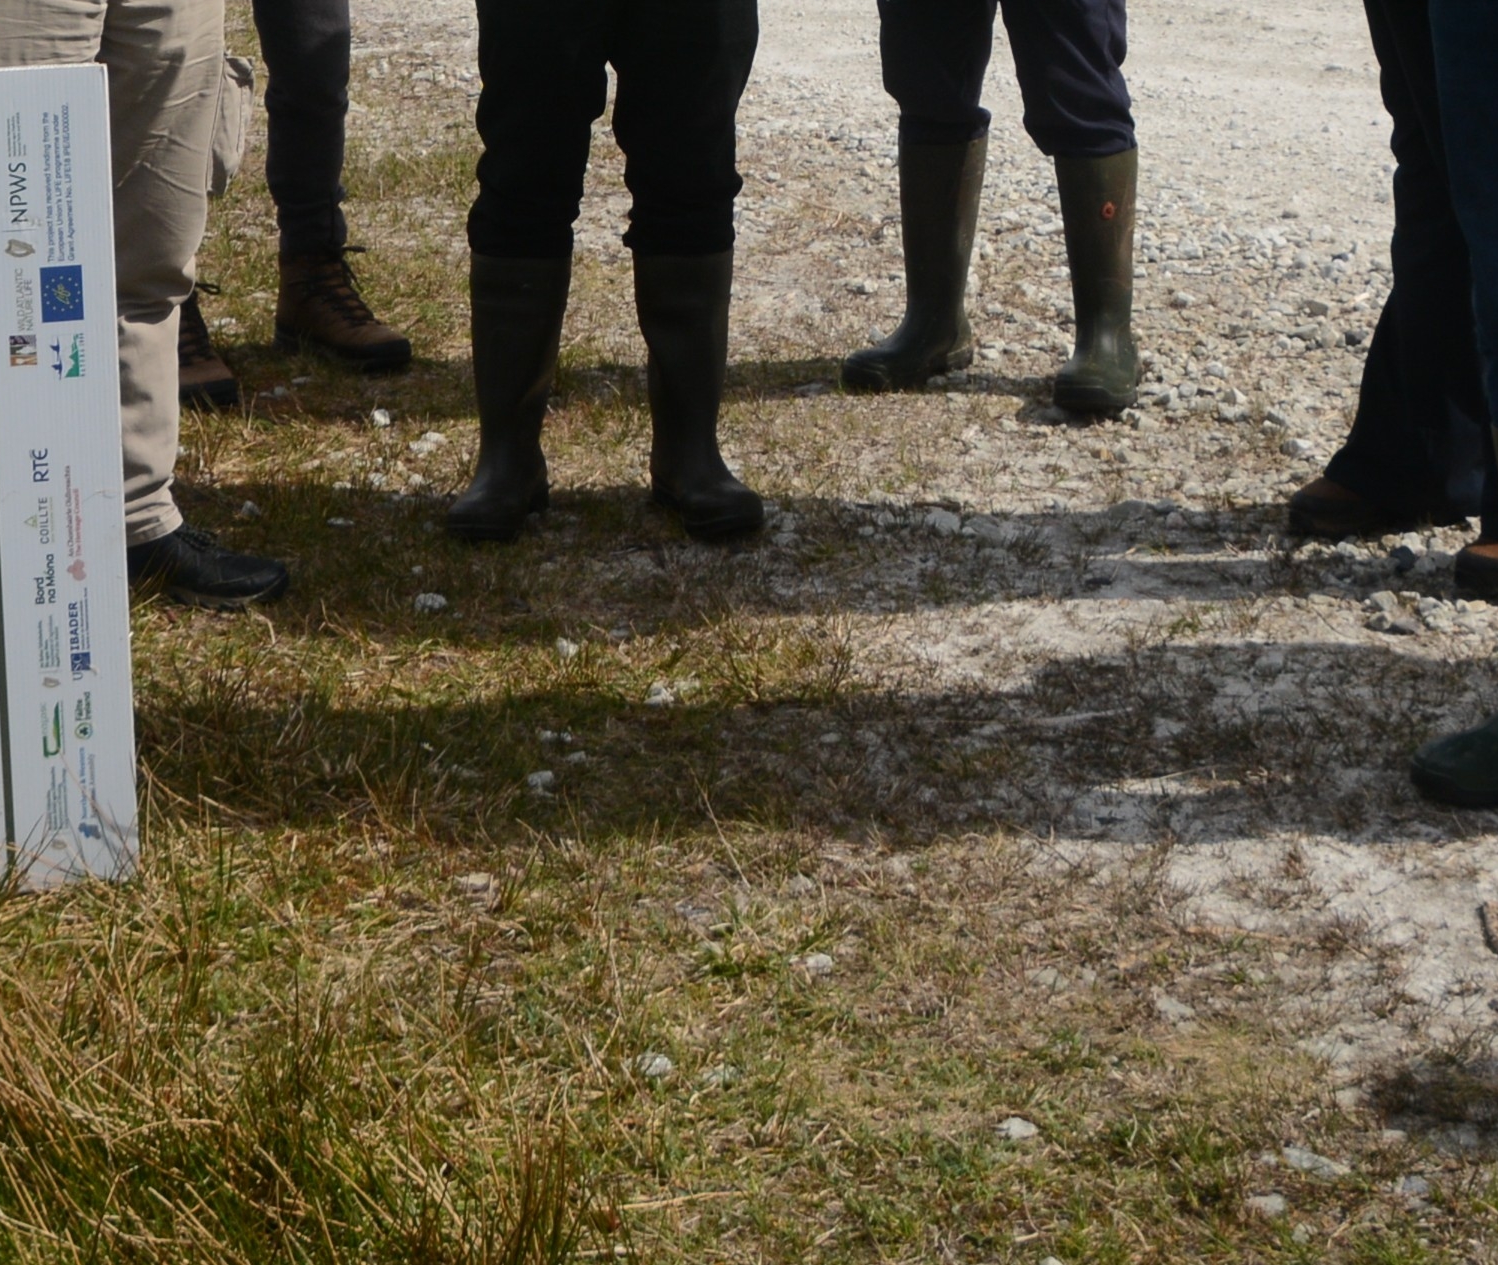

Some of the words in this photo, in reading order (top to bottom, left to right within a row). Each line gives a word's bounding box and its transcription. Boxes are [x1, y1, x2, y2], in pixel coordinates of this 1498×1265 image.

[42, 125, 50, 143] from
[52, 114, 60, 135] under
[43, 144, 52, 172] funding
[53, 137, 63, 179] programme
[8, 162, 28, 224] NPWS
[44, 173, 52, 204] received
[54, 180, 62, 198] LIFE
[44, 205, 53, 219] has
[54, 198, 64, 226] Union's
[65, 199, 76, 239] Agreement
[45, 220, 55, 246] project
[55, 227, 65, 262] European
[47, 247, 55, 263] This
[66, 240, 75, 262] Grant
[15, 268, 23, 307] ATLANTIC
[25, 299, 34, 331] NATURE
[38, 497, 50, 544] COILLTE
[44, 553, 56, 586] Móna
[34, 577, 46, 605] Bord
[48, 589, 56, 604] na
[68, 601, 80, 651] IBADER
[83, 691, 92, 721] Ireland
